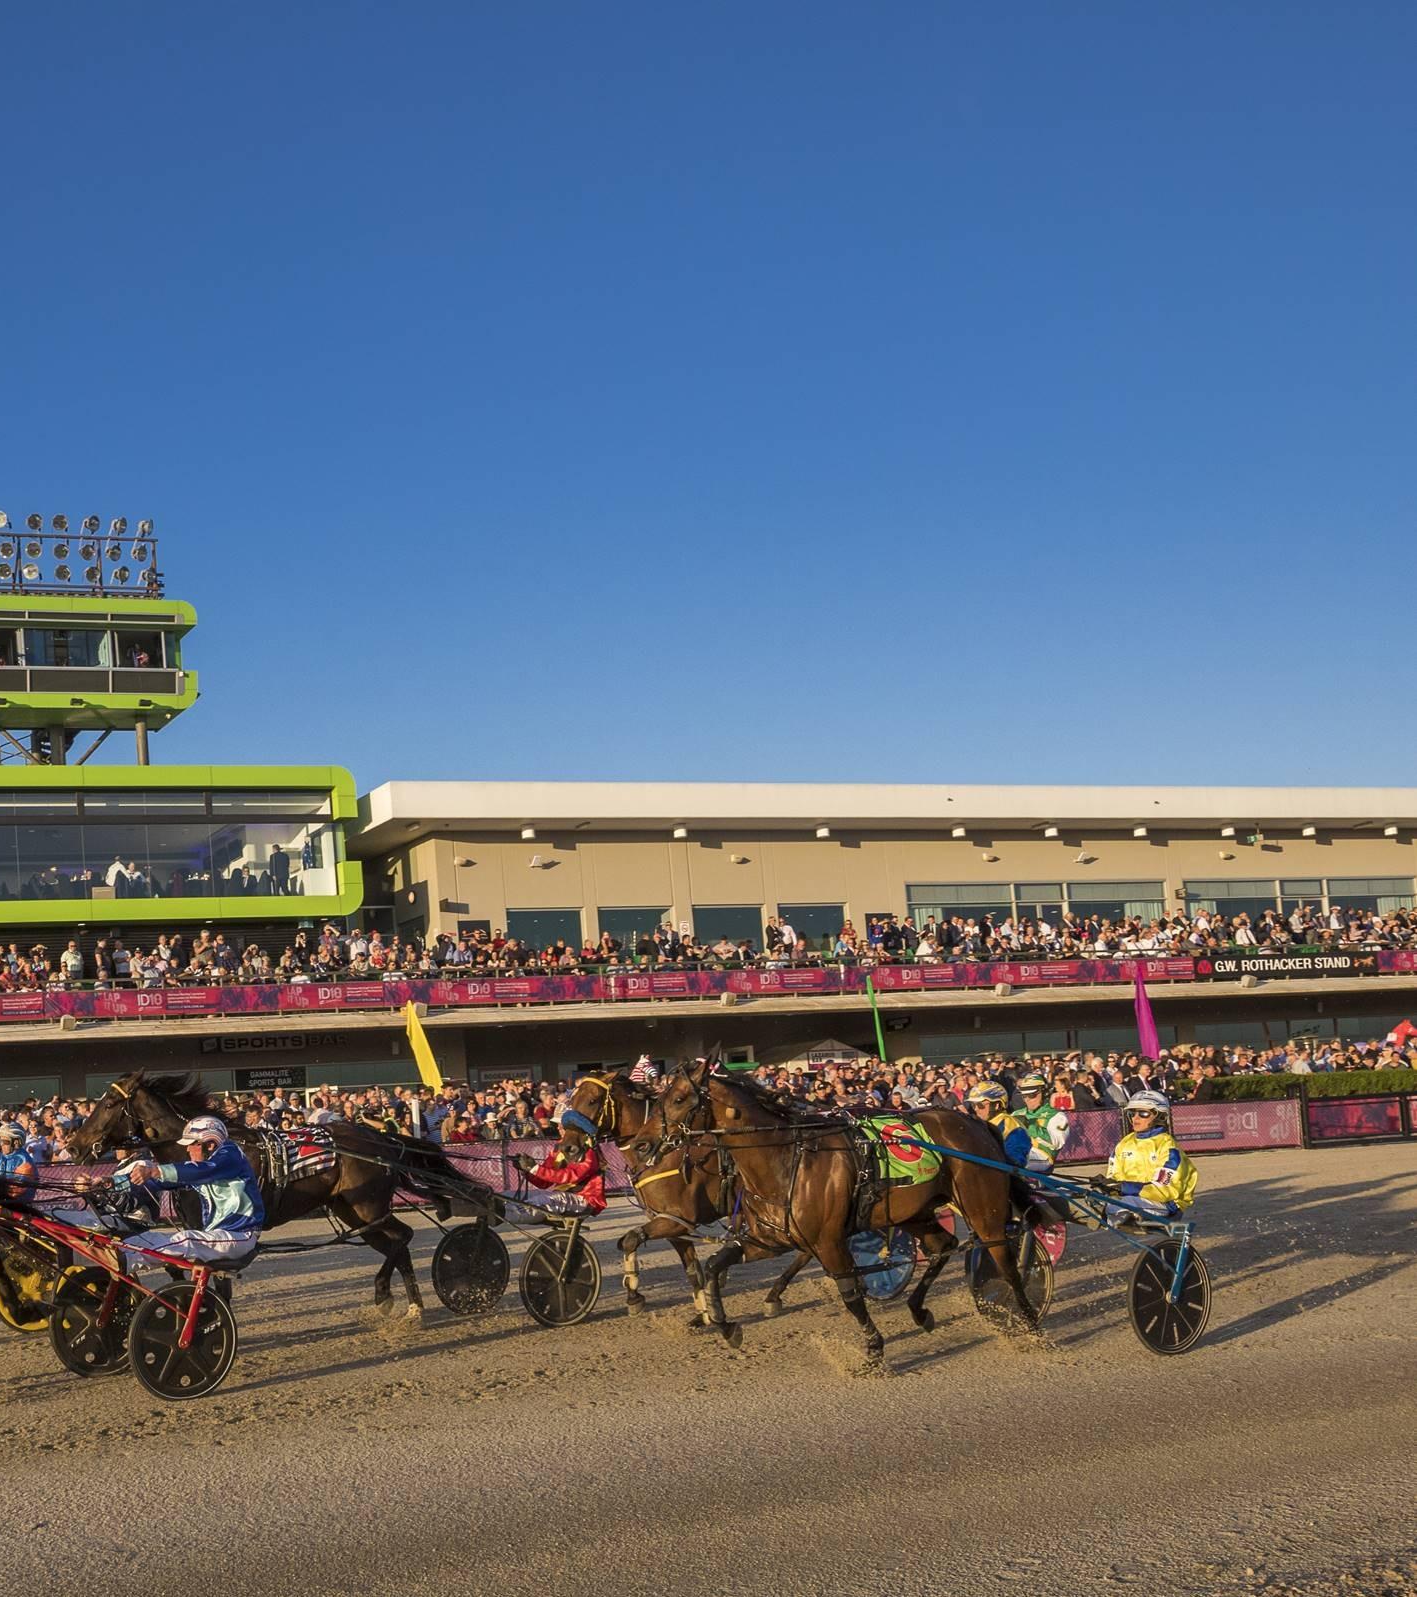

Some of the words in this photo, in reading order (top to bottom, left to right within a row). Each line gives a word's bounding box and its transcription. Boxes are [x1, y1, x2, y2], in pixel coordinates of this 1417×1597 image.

[1215, 960, 1238, 972] G.W.
[1242, 958, 1312, 972] ROTHACKER
[1314, 956, 1350, 968] STAND
[318, 987, 342, 1000] ID18
[468, 983, 490, 994] ID18
[137, 993, 162, 1006] ID18
[224, 1036, 303, 1049] SPORTS
[250, 1069, 289, 1079] GAMMALITE
[248, 1079, 275, 1087] SPORTS
[278, 1077, 292, 1085] BAR
[881, 1123, 924, 1163] 6
